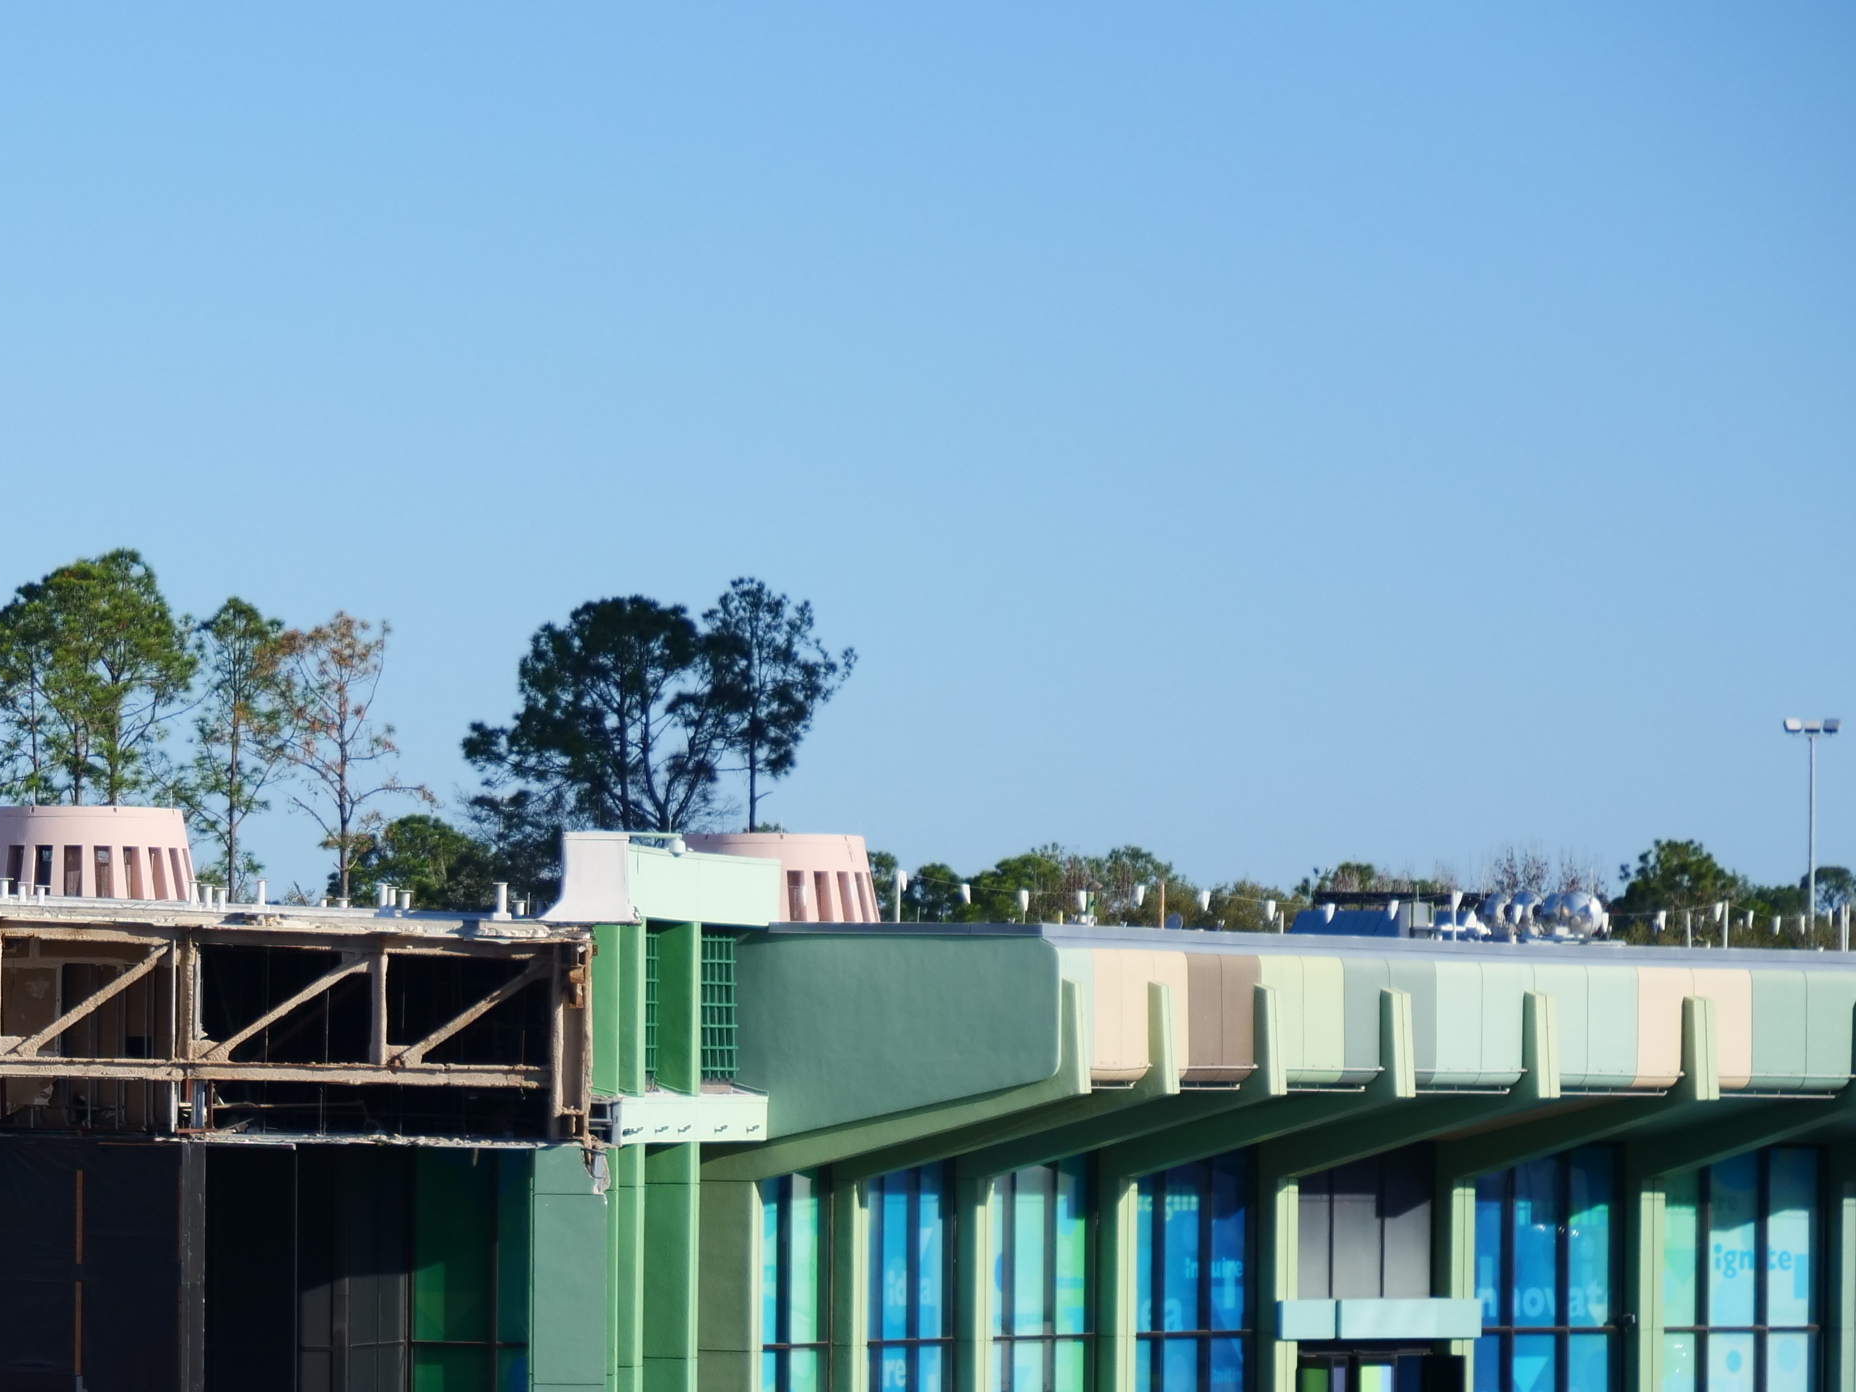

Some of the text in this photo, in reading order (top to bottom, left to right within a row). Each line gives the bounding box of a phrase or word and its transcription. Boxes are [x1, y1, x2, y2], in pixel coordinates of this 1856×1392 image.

[1185, 1257, 1243, 1289] inuire
[1714, 1243, 1793, 1279] ignte
[887, 1267, 932, 1306] ida
